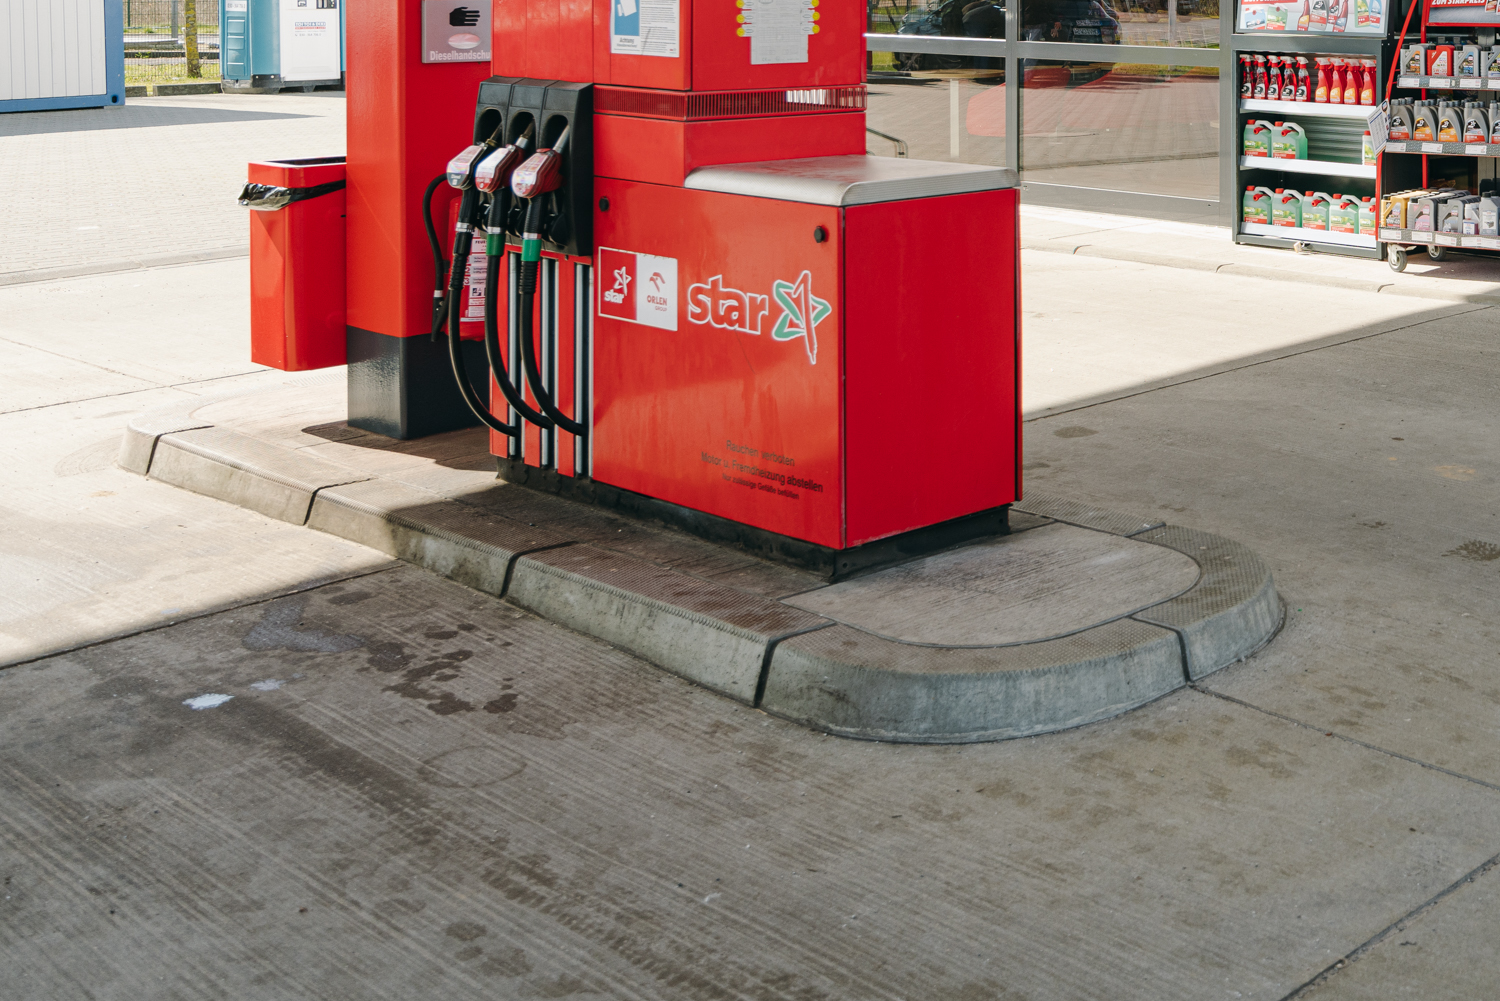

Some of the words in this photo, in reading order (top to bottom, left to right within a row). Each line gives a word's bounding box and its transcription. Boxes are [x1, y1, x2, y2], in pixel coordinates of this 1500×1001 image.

[604, 288, 625, 304] star
[646, 295, 668, 307] ORLEN
[688, 274, 769, 335] star
[726, 439, 759, 458] Rauchen
[761, 450, 796, 467] verboten
[701, 451, 722, 466] Motor
[723, 460, 730, 469] u.
[731, 459, 786, 486] Fremdheizung
[786, 474, 824, 493] abstellen
[777, 487, 800, 500] befüllen
